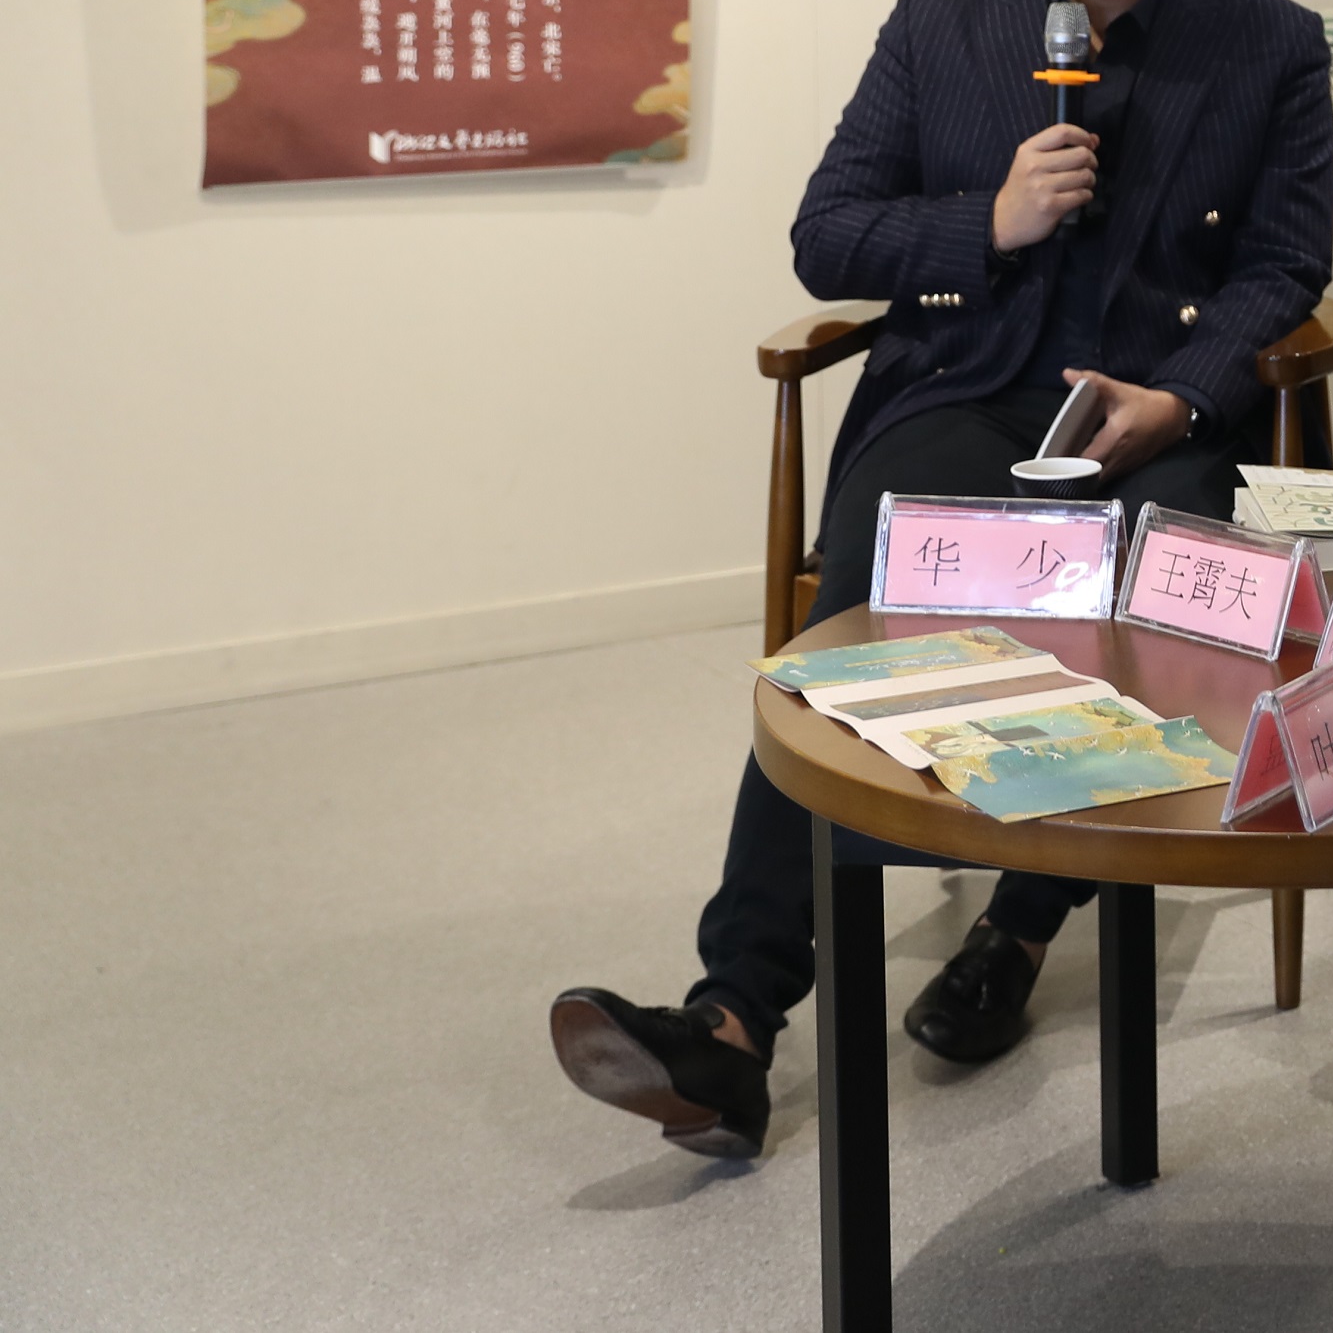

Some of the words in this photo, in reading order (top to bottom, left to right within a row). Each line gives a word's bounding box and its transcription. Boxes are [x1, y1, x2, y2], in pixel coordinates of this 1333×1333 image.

[912, 534, 962, 589] 华
[1015, 538, 1069, 590] 少
[1149, 547, 1259, 621] 王霄夫
